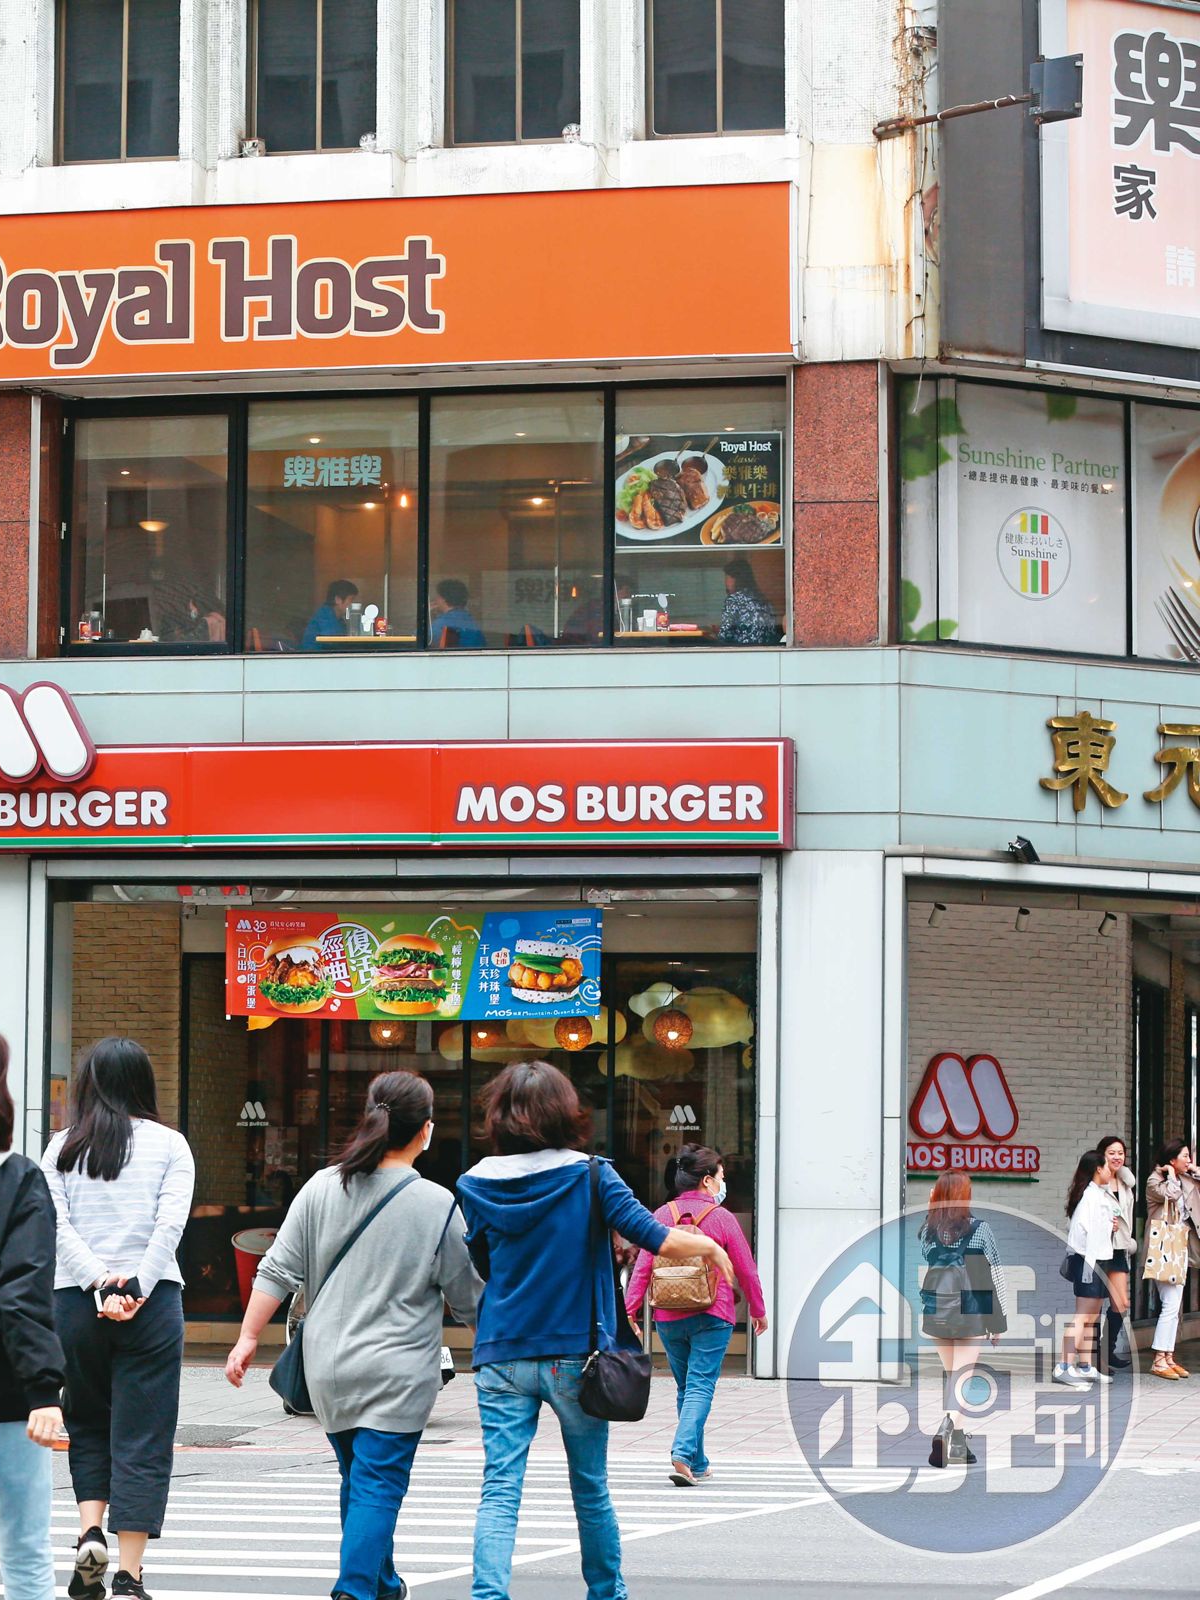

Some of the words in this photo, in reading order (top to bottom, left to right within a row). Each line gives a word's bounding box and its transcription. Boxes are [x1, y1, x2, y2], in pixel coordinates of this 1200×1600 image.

[1113, 163, 1157, 220] 家
[208, 234, 445, 342] Host
[720, 441, 747, 454] Royal
[748, 440, 772, 452] Host
[959, 442, 1046, 471] Sunshine
[1052, 452, 1119, 479] Partner
[283, 454, 382, 487] 樂雅樂
[1011, 545, 1058, 560] Sunshine
[456, 784, 565, 823] MOS
[576, 784, 763, 822] BURGER
[951, 1147, 1037, 1169] BURGER
